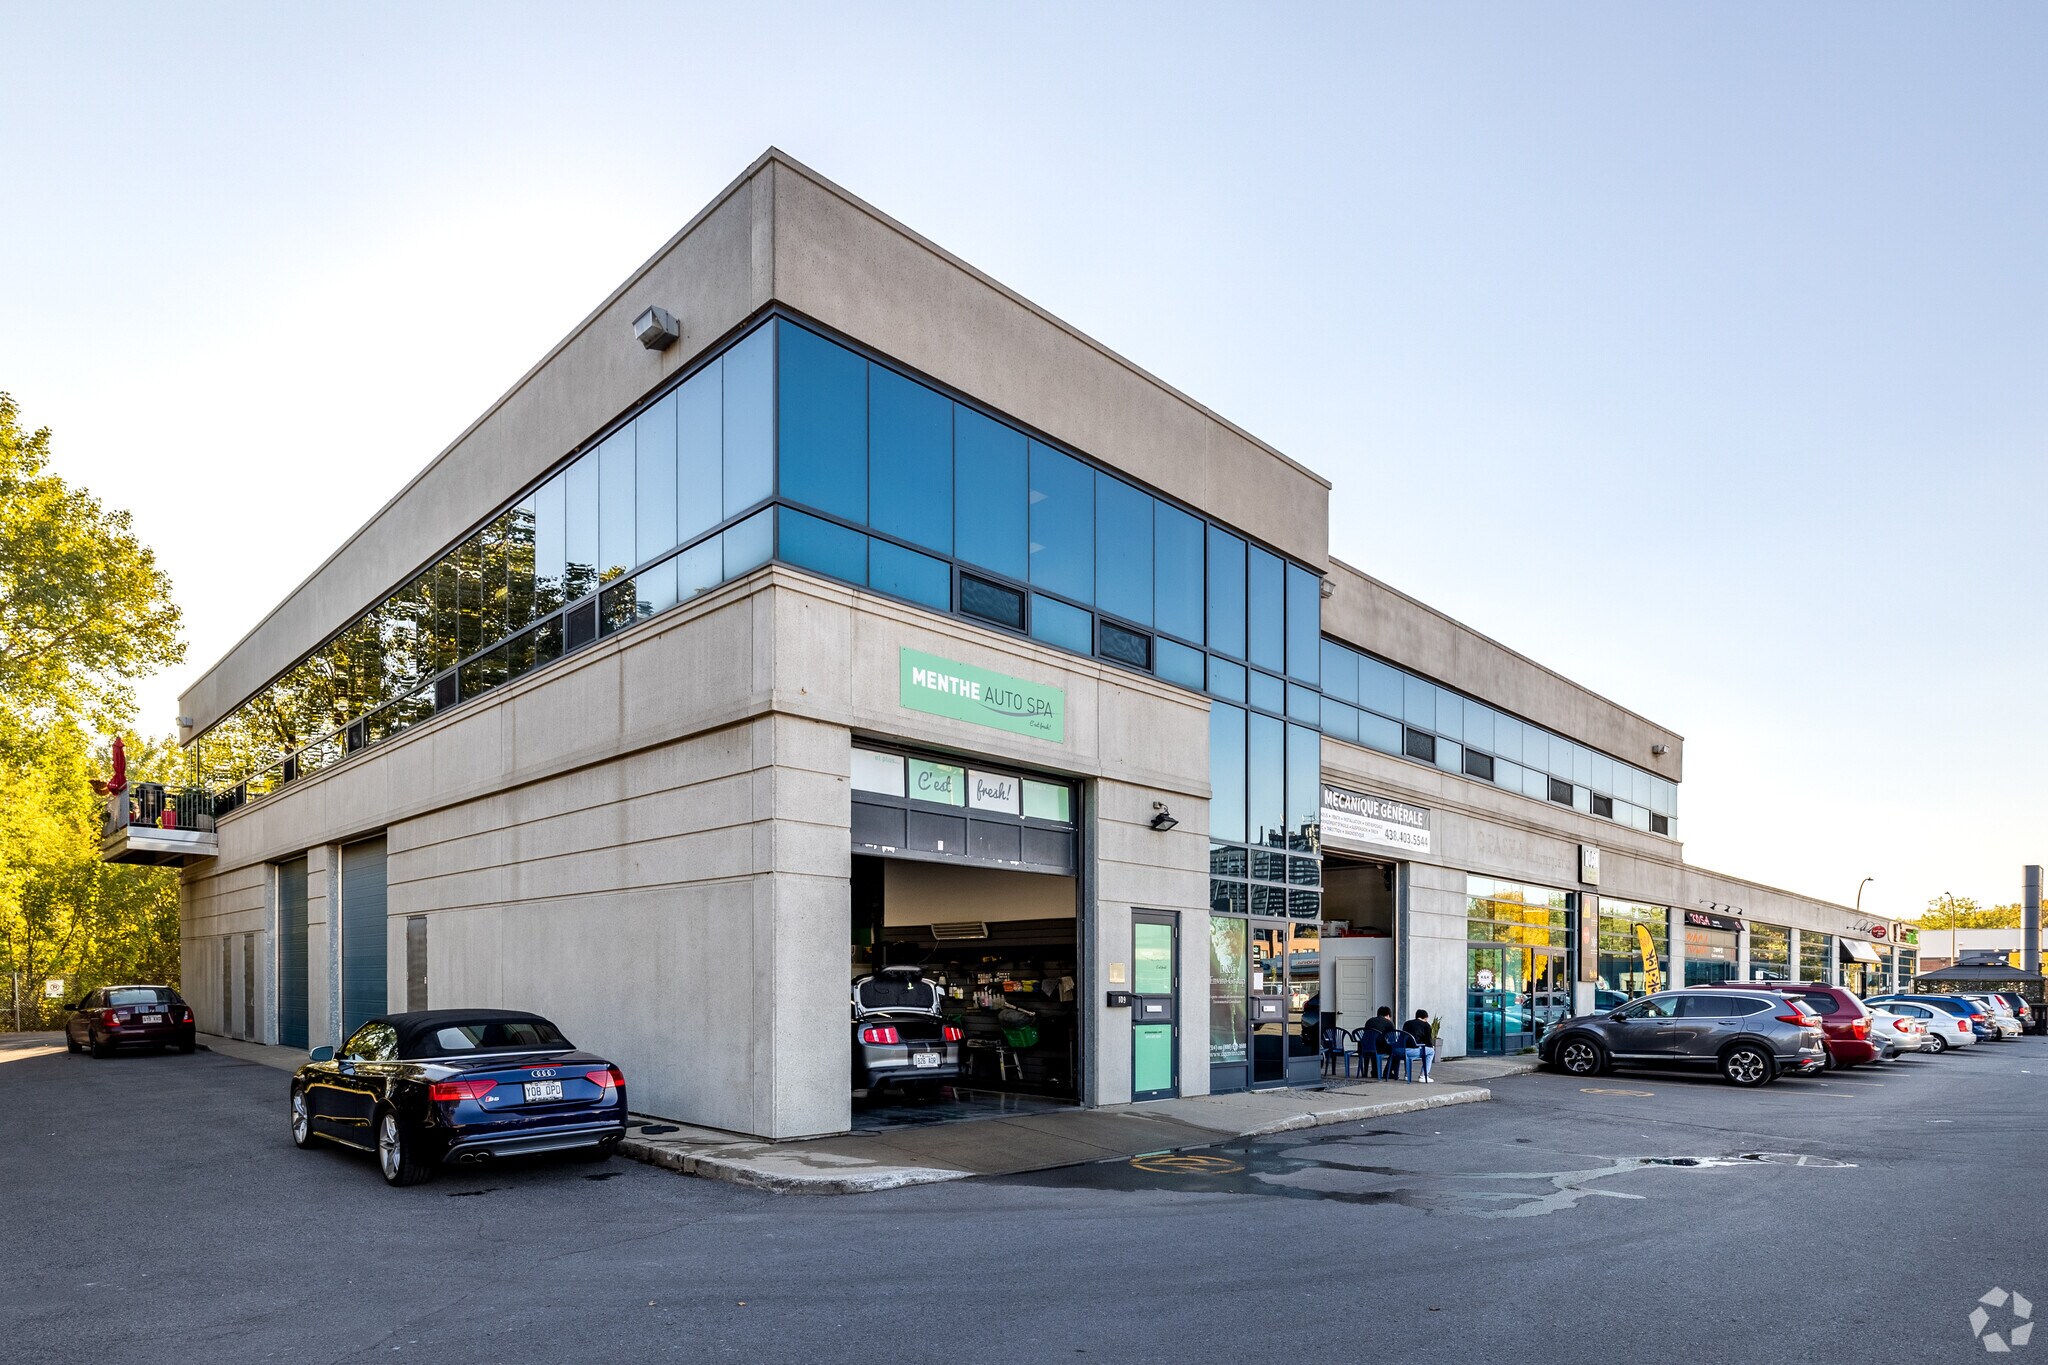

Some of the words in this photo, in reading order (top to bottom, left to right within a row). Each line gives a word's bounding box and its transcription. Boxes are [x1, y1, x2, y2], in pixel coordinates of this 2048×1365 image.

[912, 667, 980, 700] MENTHE
[984, 686, 1023, 710] AUTO
[1026, 697, 1053, 718] SPA
[918, 771, 952, 792] C'est
[976, 778, 1012, 801] fresh!
[1381, 801, 1423, 826] GÉNÉRALE
[526, 1086, 542, 1097] Y08
